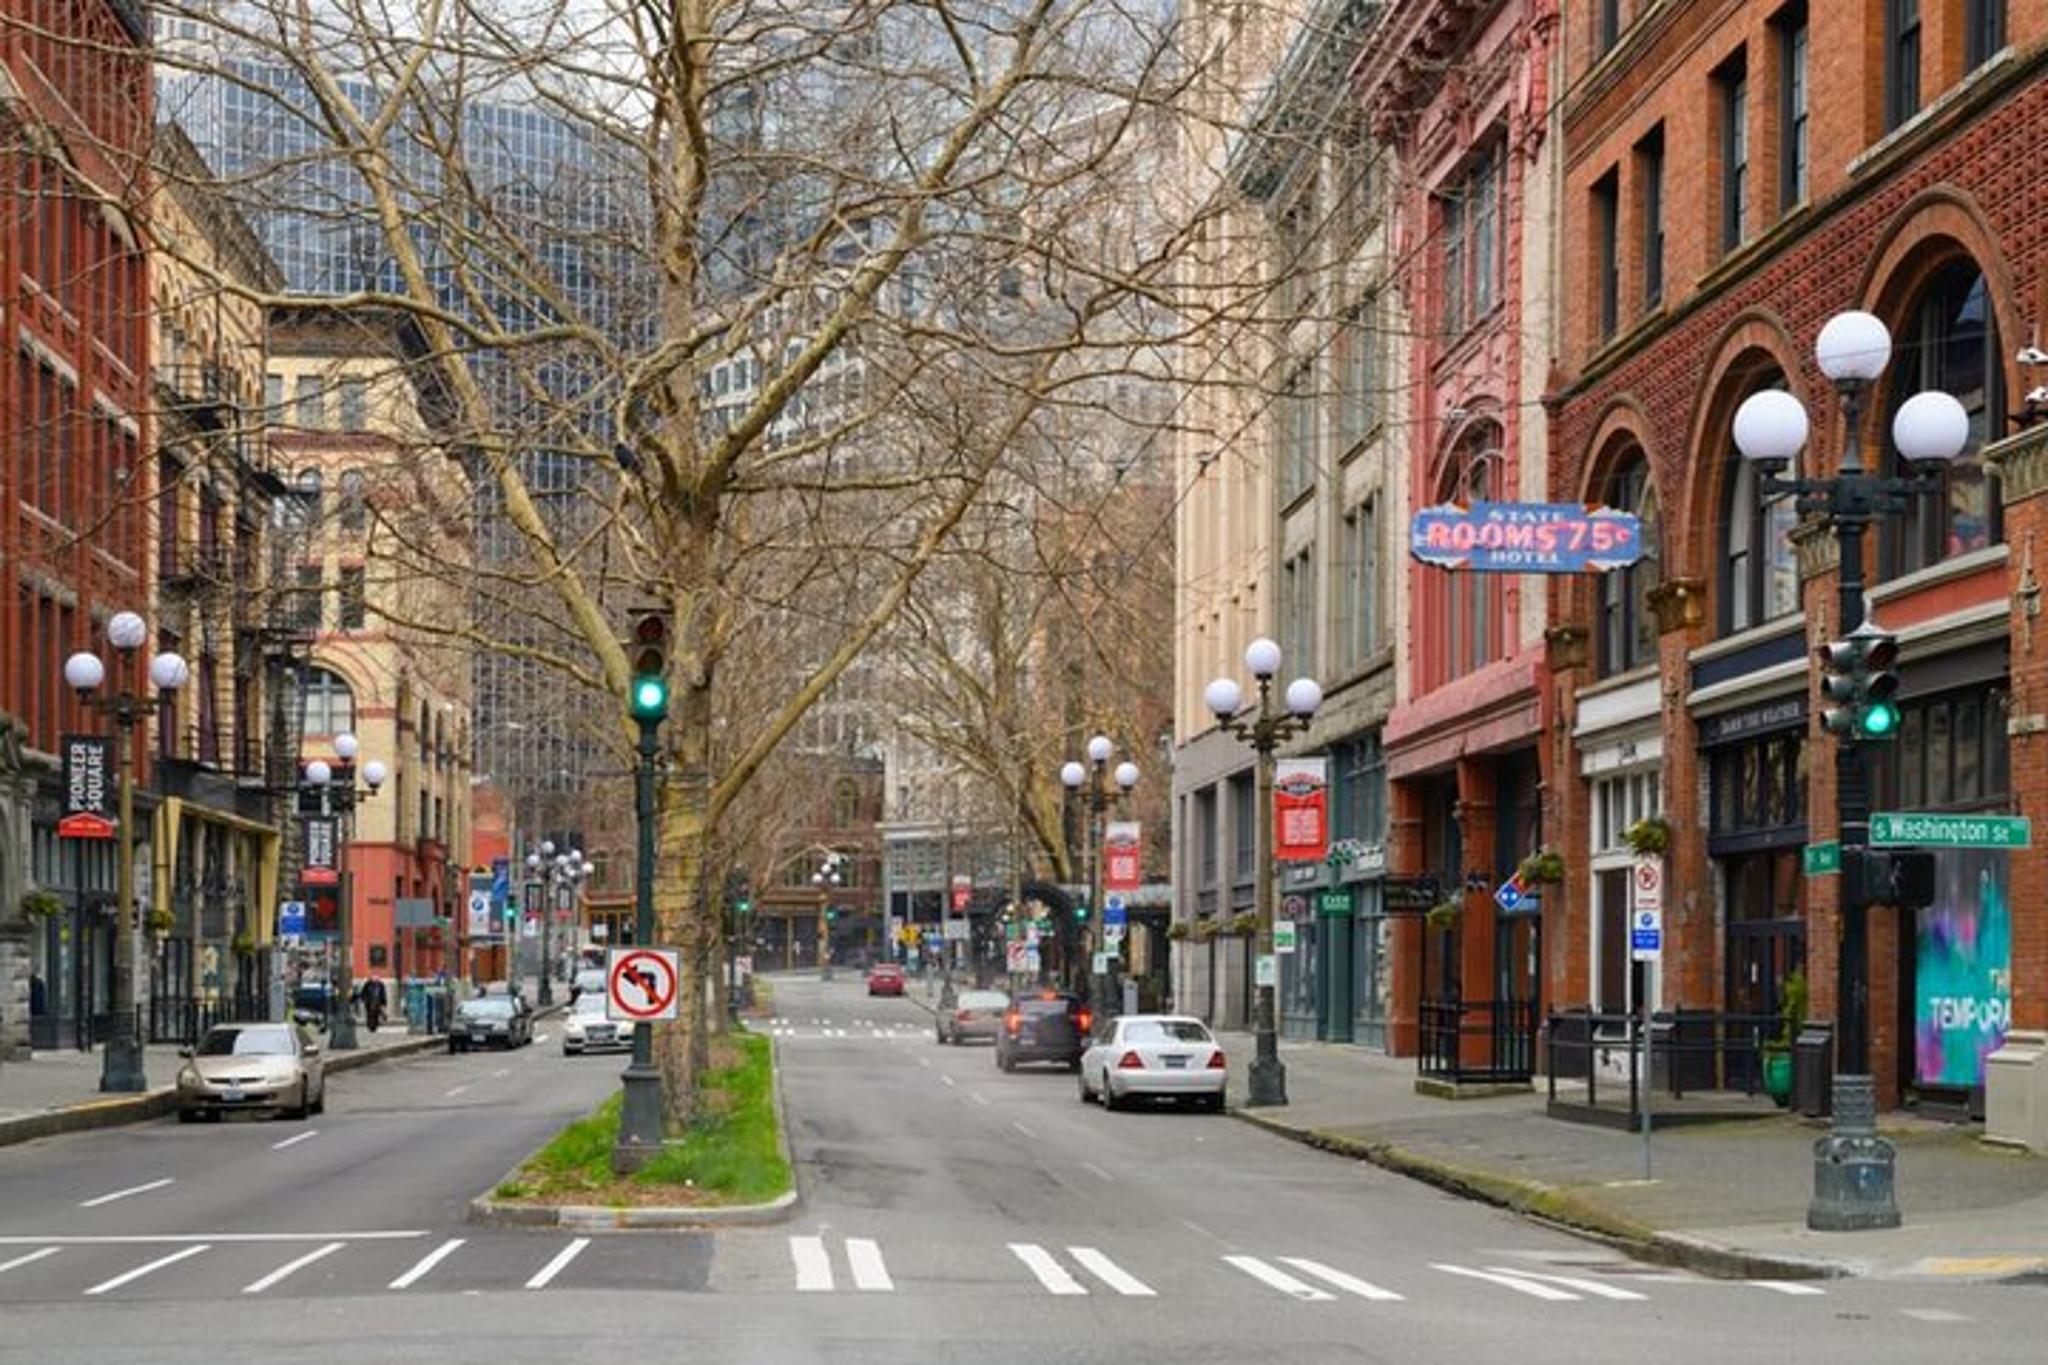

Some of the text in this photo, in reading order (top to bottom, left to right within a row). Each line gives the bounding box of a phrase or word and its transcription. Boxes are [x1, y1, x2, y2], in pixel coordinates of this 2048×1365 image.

[1488, 510, 1565, 522] STATE
[1426, 521, 1558, 551] ROOMS
[1491, 551, 1560, 564] HOTEL
[70, 743, 87, 811] PIONEER
[87, 744, 104, 811] SQUARE
[1874, 816, 2009, 843] S Washington St
